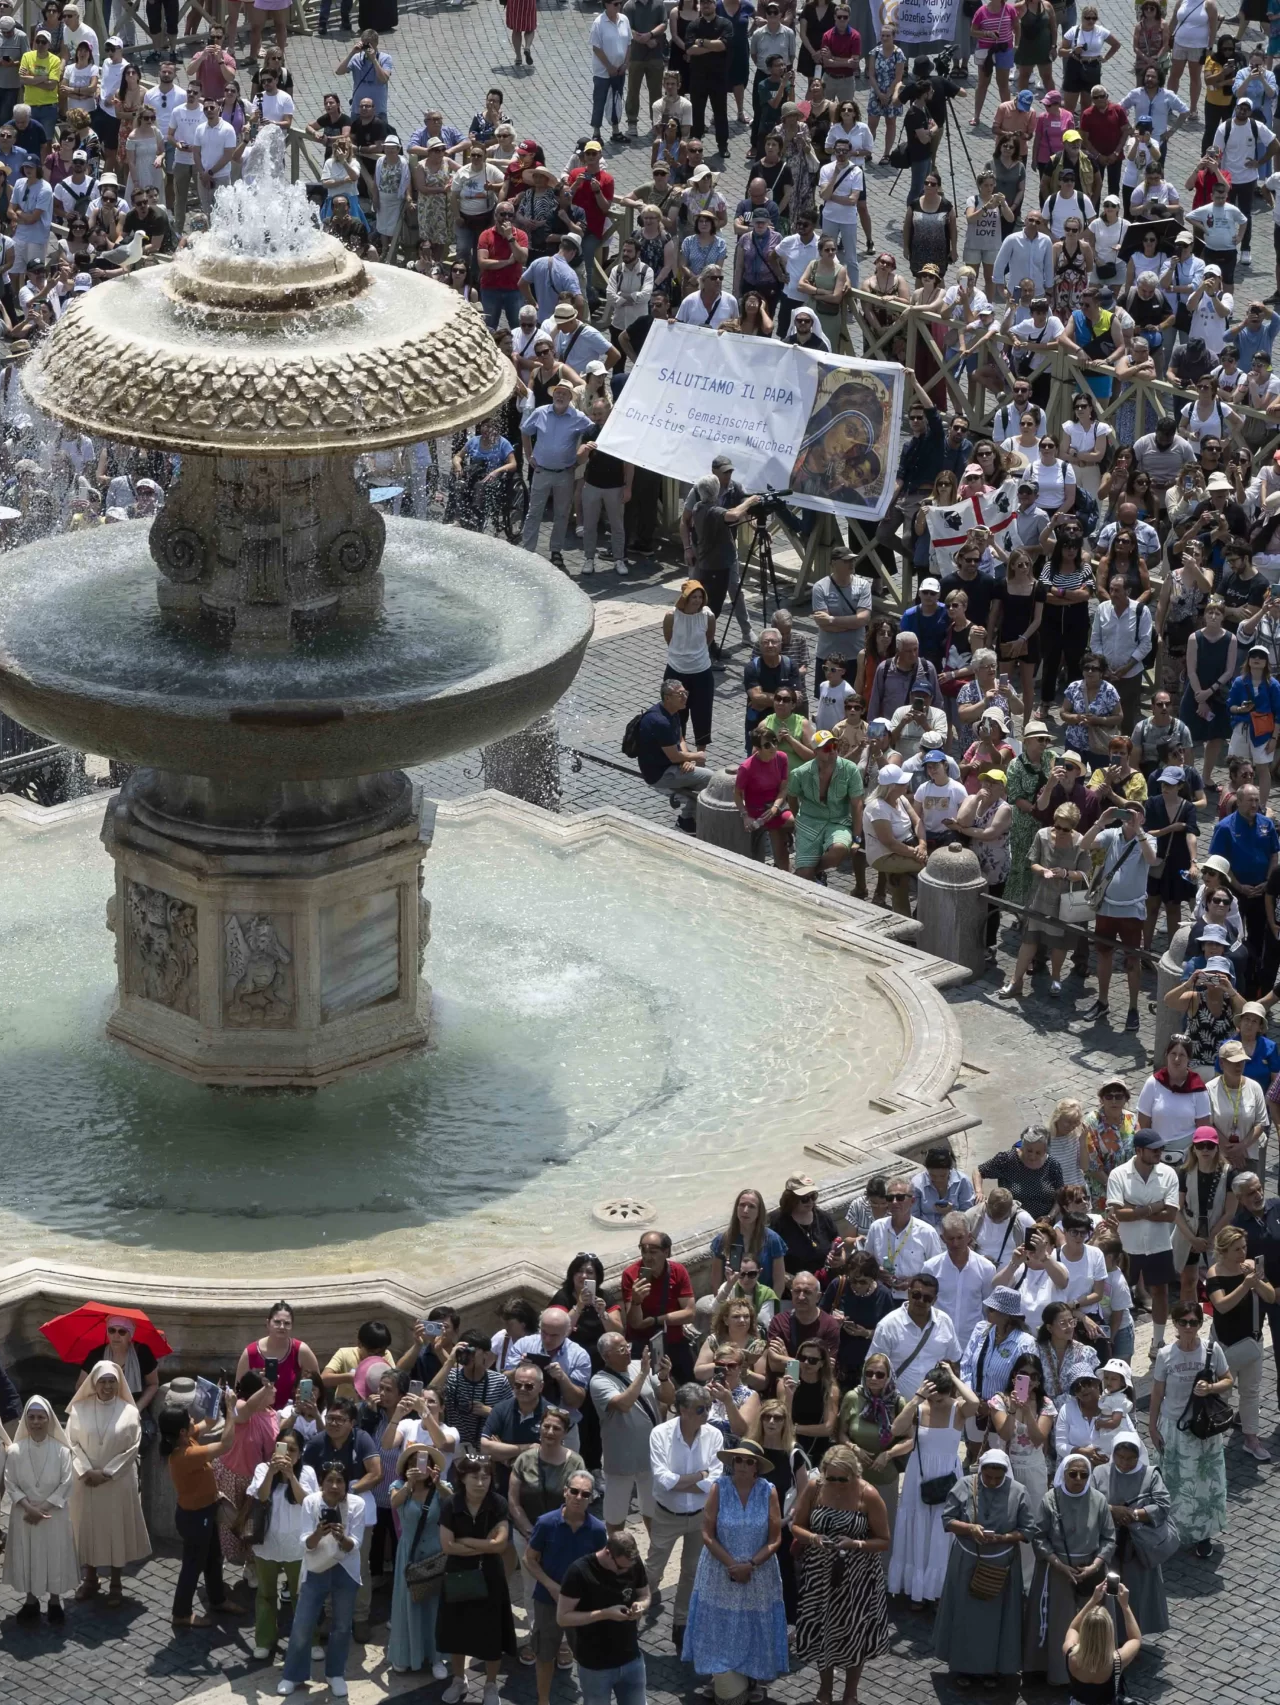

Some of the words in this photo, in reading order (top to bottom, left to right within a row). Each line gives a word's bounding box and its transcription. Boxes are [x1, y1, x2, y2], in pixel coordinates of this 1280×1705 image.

[900, 10, 926, 24] Józefie
[982, 211, 998, 219] OVE
[976, 219, 997, 228] LOVE
[975, 229, 996, 237] LOVE
[658, 368, 735, 395] SALUTIAMO
[742, 384, 755, 400] IL
[763, 388, 793, 405] PAPA
[665, 403, 678, 416] 5.
[688, 407, 768, 433] Gemeinschaft
[625, 407, 685, 433] Christus
[692, 426, 740, 445] Erlöser
[746, 435, 793, 455] München
